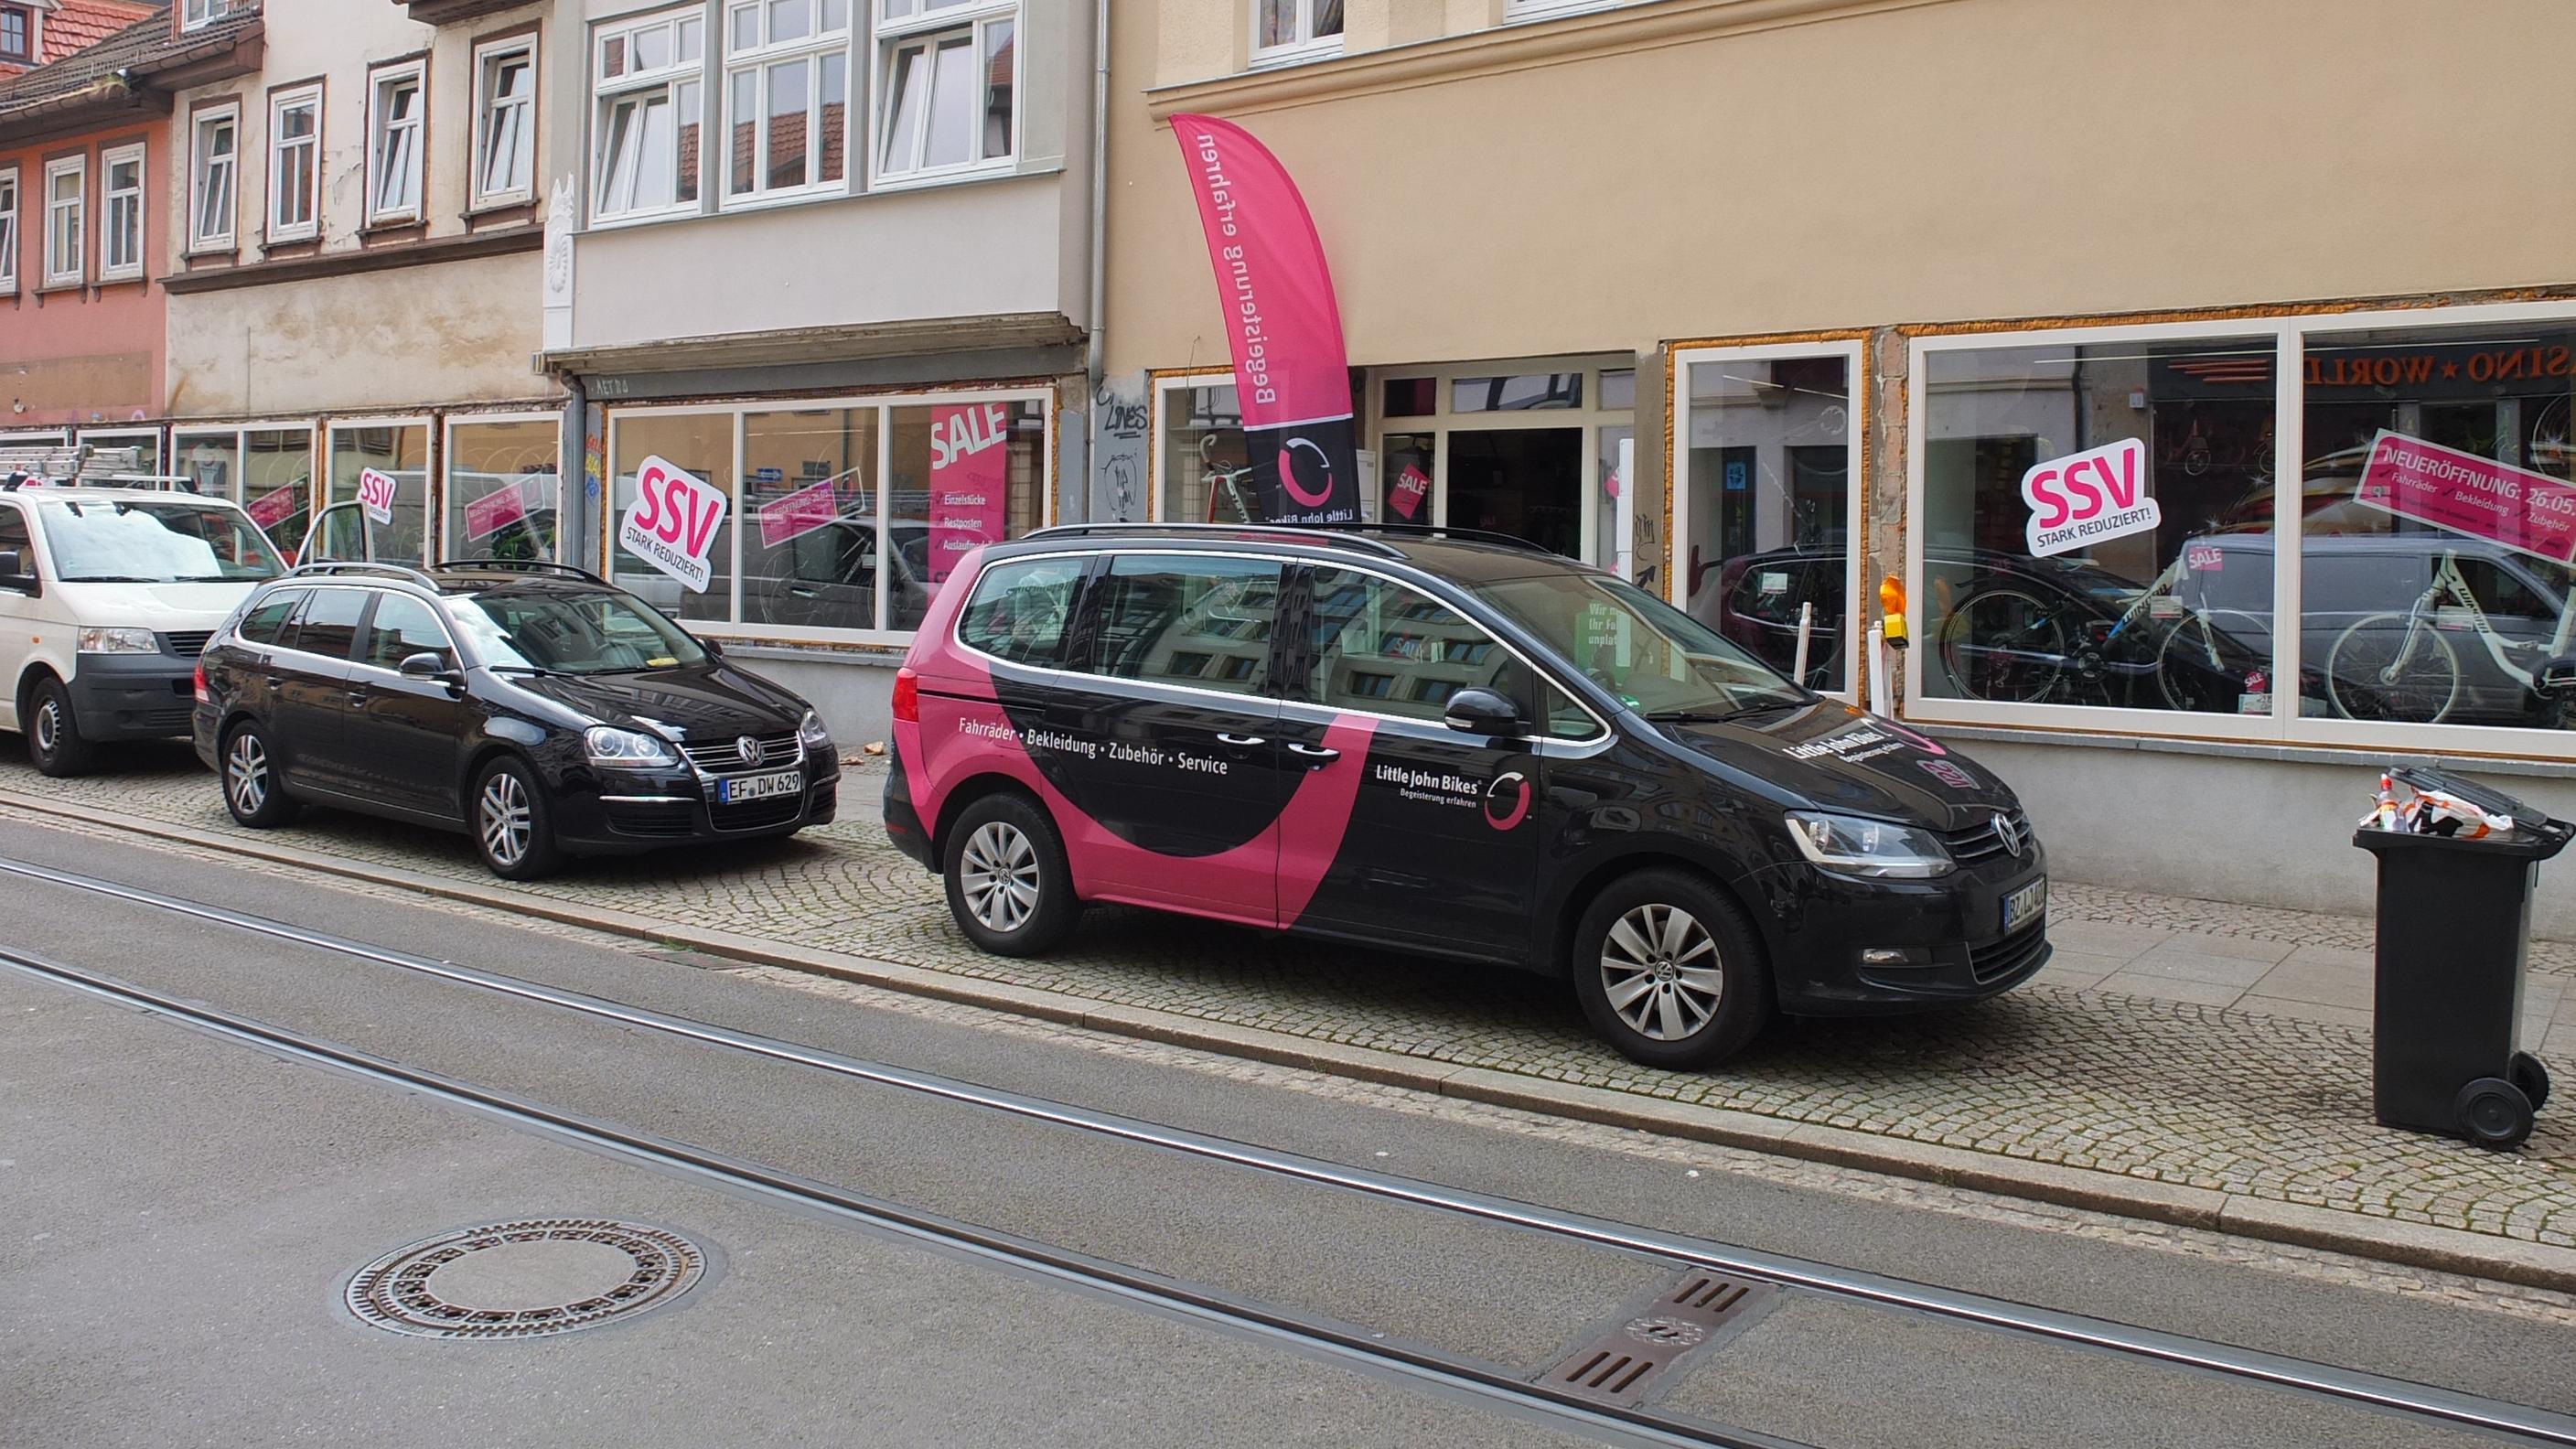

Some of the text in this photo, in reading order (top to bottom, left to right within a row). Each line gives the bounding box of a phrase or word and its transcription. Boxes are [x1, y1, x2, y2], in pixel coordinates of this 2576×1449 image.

[930, 402, 1007, 470] SALE
[361, 472, 393, 510] SSV
[1397, 472, 1427, 496] SALE
[2031, 447, 2135, 528] SSV
[2384, 446, 2522, 499] NEUERÖFFNUNG:
[634, 467, 720, 559] SSV
[2391, 472, 2439, 494] Fahrräder
[2454, 490, 2510, 517] Bekleidung
[2527, 511, 2571, 532] Zubehör
[2037, 508, 2152, 548] STARK REDUZIERT!
[626, 527, 704, 583] STARK REDUZIERT!
[2188, 547, 2223, 569] SALE
[959, 717, 1228, 775] Fahrräder Bekleidung Zubehör Service
[728, 774, 800, 799] EF DW 629
[1376, 764, 1409, 783] Little
[1410, 770, 1440, 789] John
[1400, 788, 1476, 809] Begeisterung erfahren
